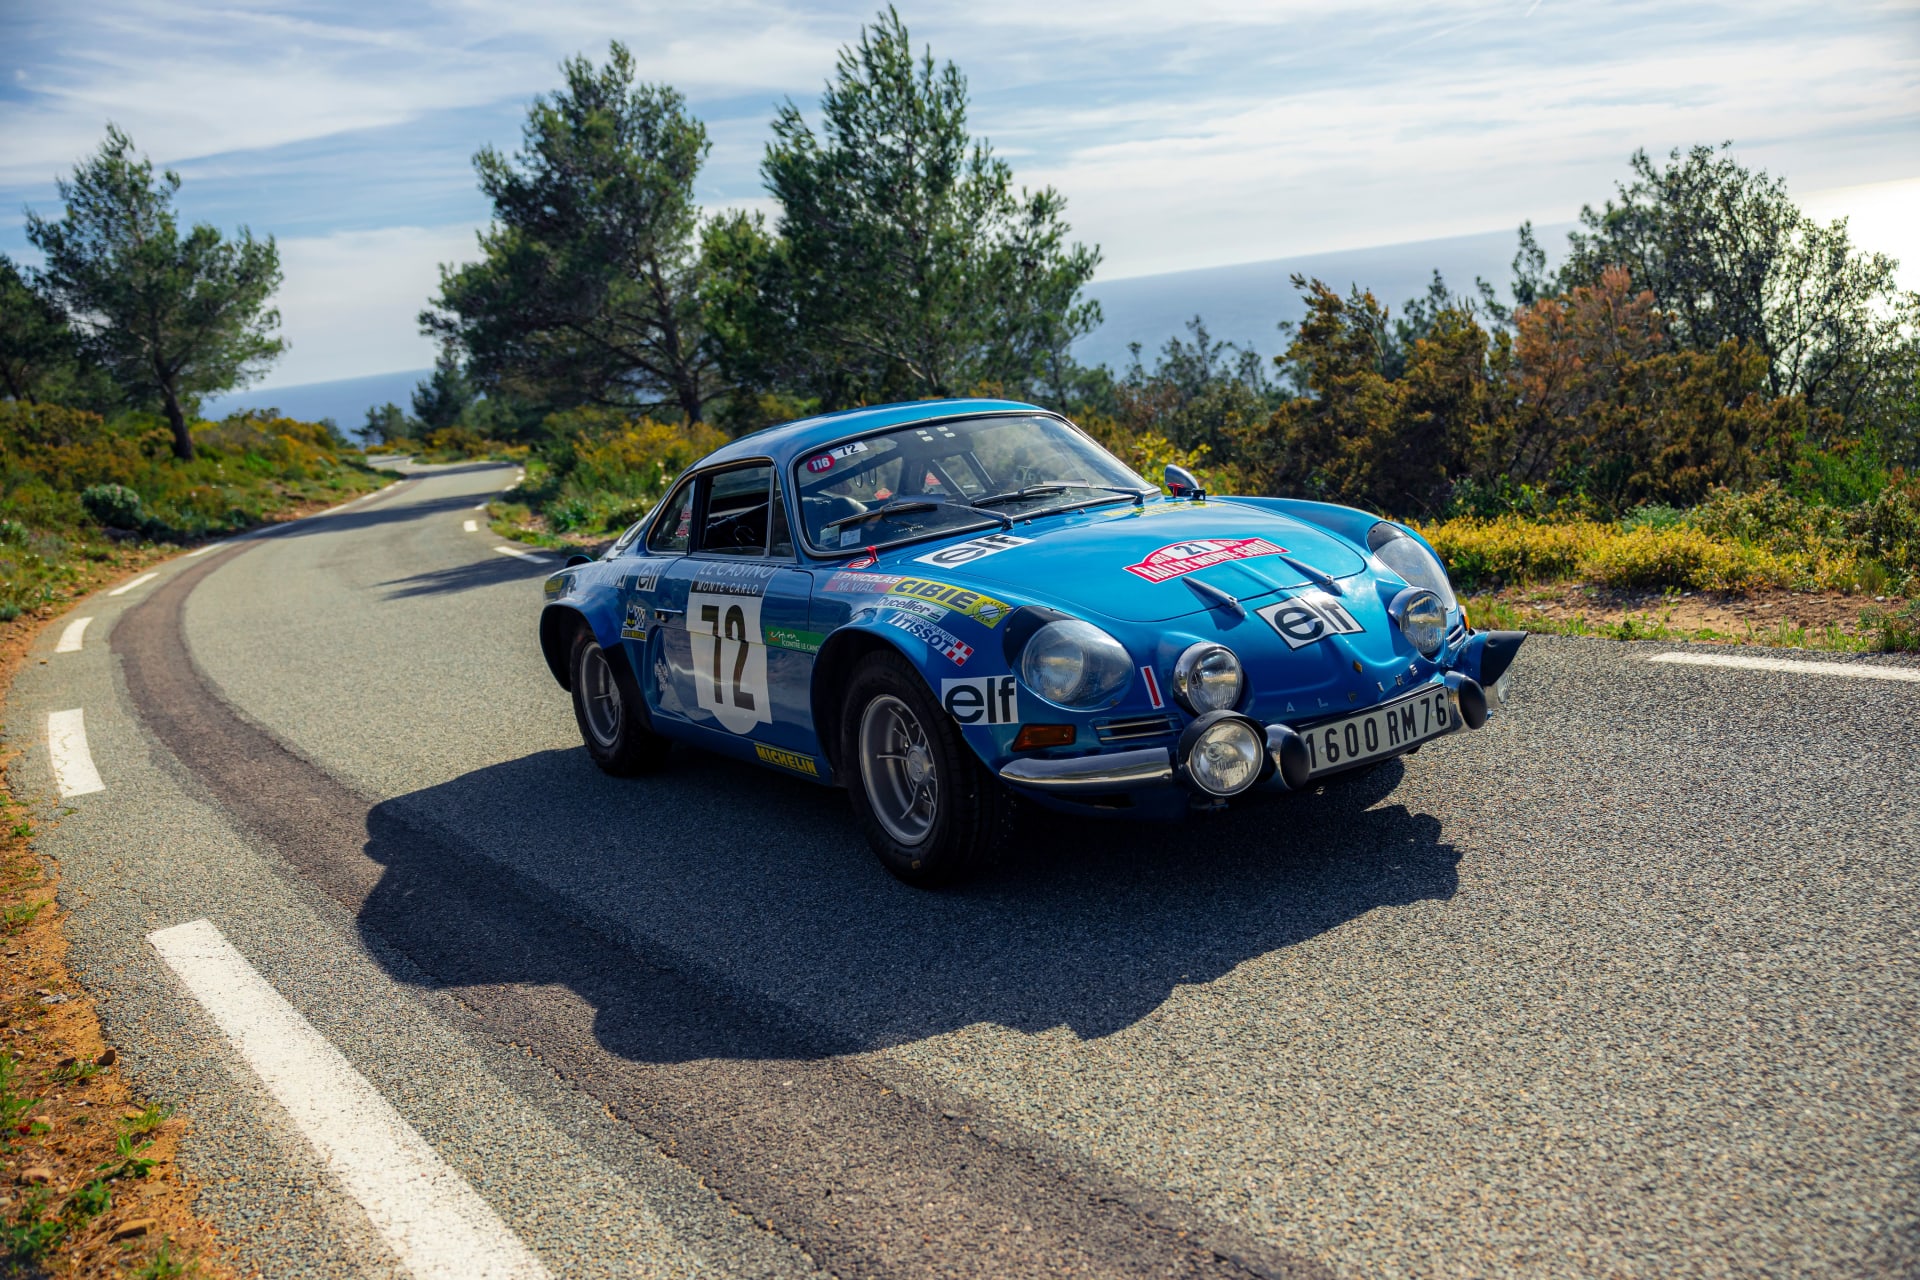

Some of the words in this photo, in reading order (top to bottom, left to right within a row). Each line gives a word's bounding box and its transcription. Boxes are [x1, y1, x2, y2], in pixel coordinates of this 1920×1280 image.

[840, 444, 859, 456] 72
[811, 458, 831, 471] 116
[932, 534, 1023, 564] elf
[1174, 543, 1212, 555] 21
[716, 563, 778, 579] CASINO
[1132, 559, 1201, 581] RALLYE
[850, 582, 876, 592] VIAL
[894, 579, 981, 611] CIBIE
[878, 596, 931, 614] Ducellier
[1274, 598, 1354, 641] elf
[898, 616, 954, 653] TISSOT
[701, 604, 755, 711] 72
[945, 676, 1016, 724] elf
[1305, 717, 1379, 769] 1600
[1387, 703, 1417, 747] RM
[1421, 693, 1447, 734] 76
[755, 747, 818, 775] MICHELIN
